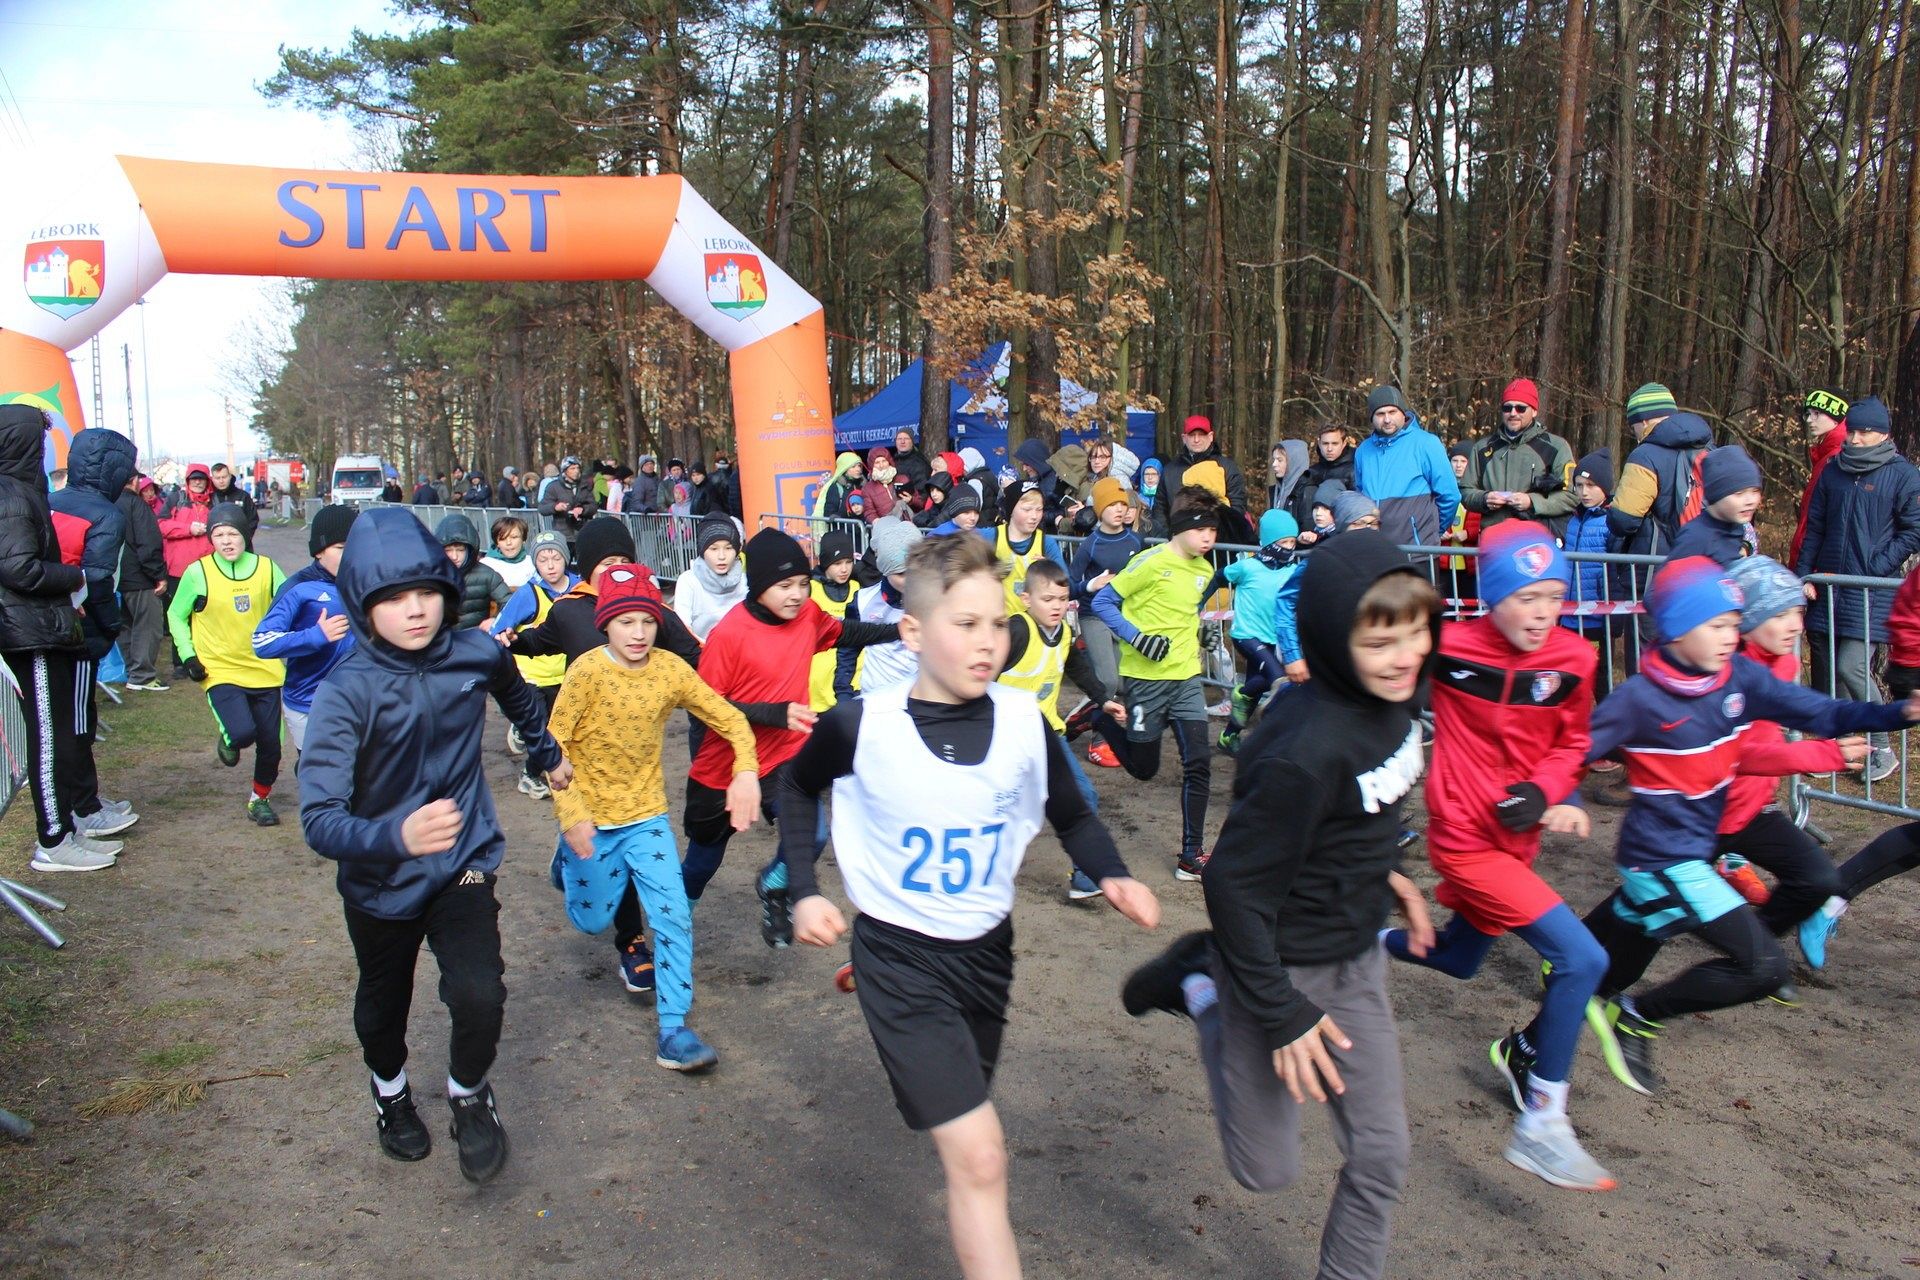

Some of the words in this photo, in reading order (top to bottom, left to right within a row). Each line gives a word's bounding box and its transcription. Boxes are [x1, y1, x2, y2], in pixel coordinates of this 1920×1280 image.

[276, 179, 561, 252] START
[1133, 705, 1146, 731] 2
[902, 822, 1008, 895] 257
